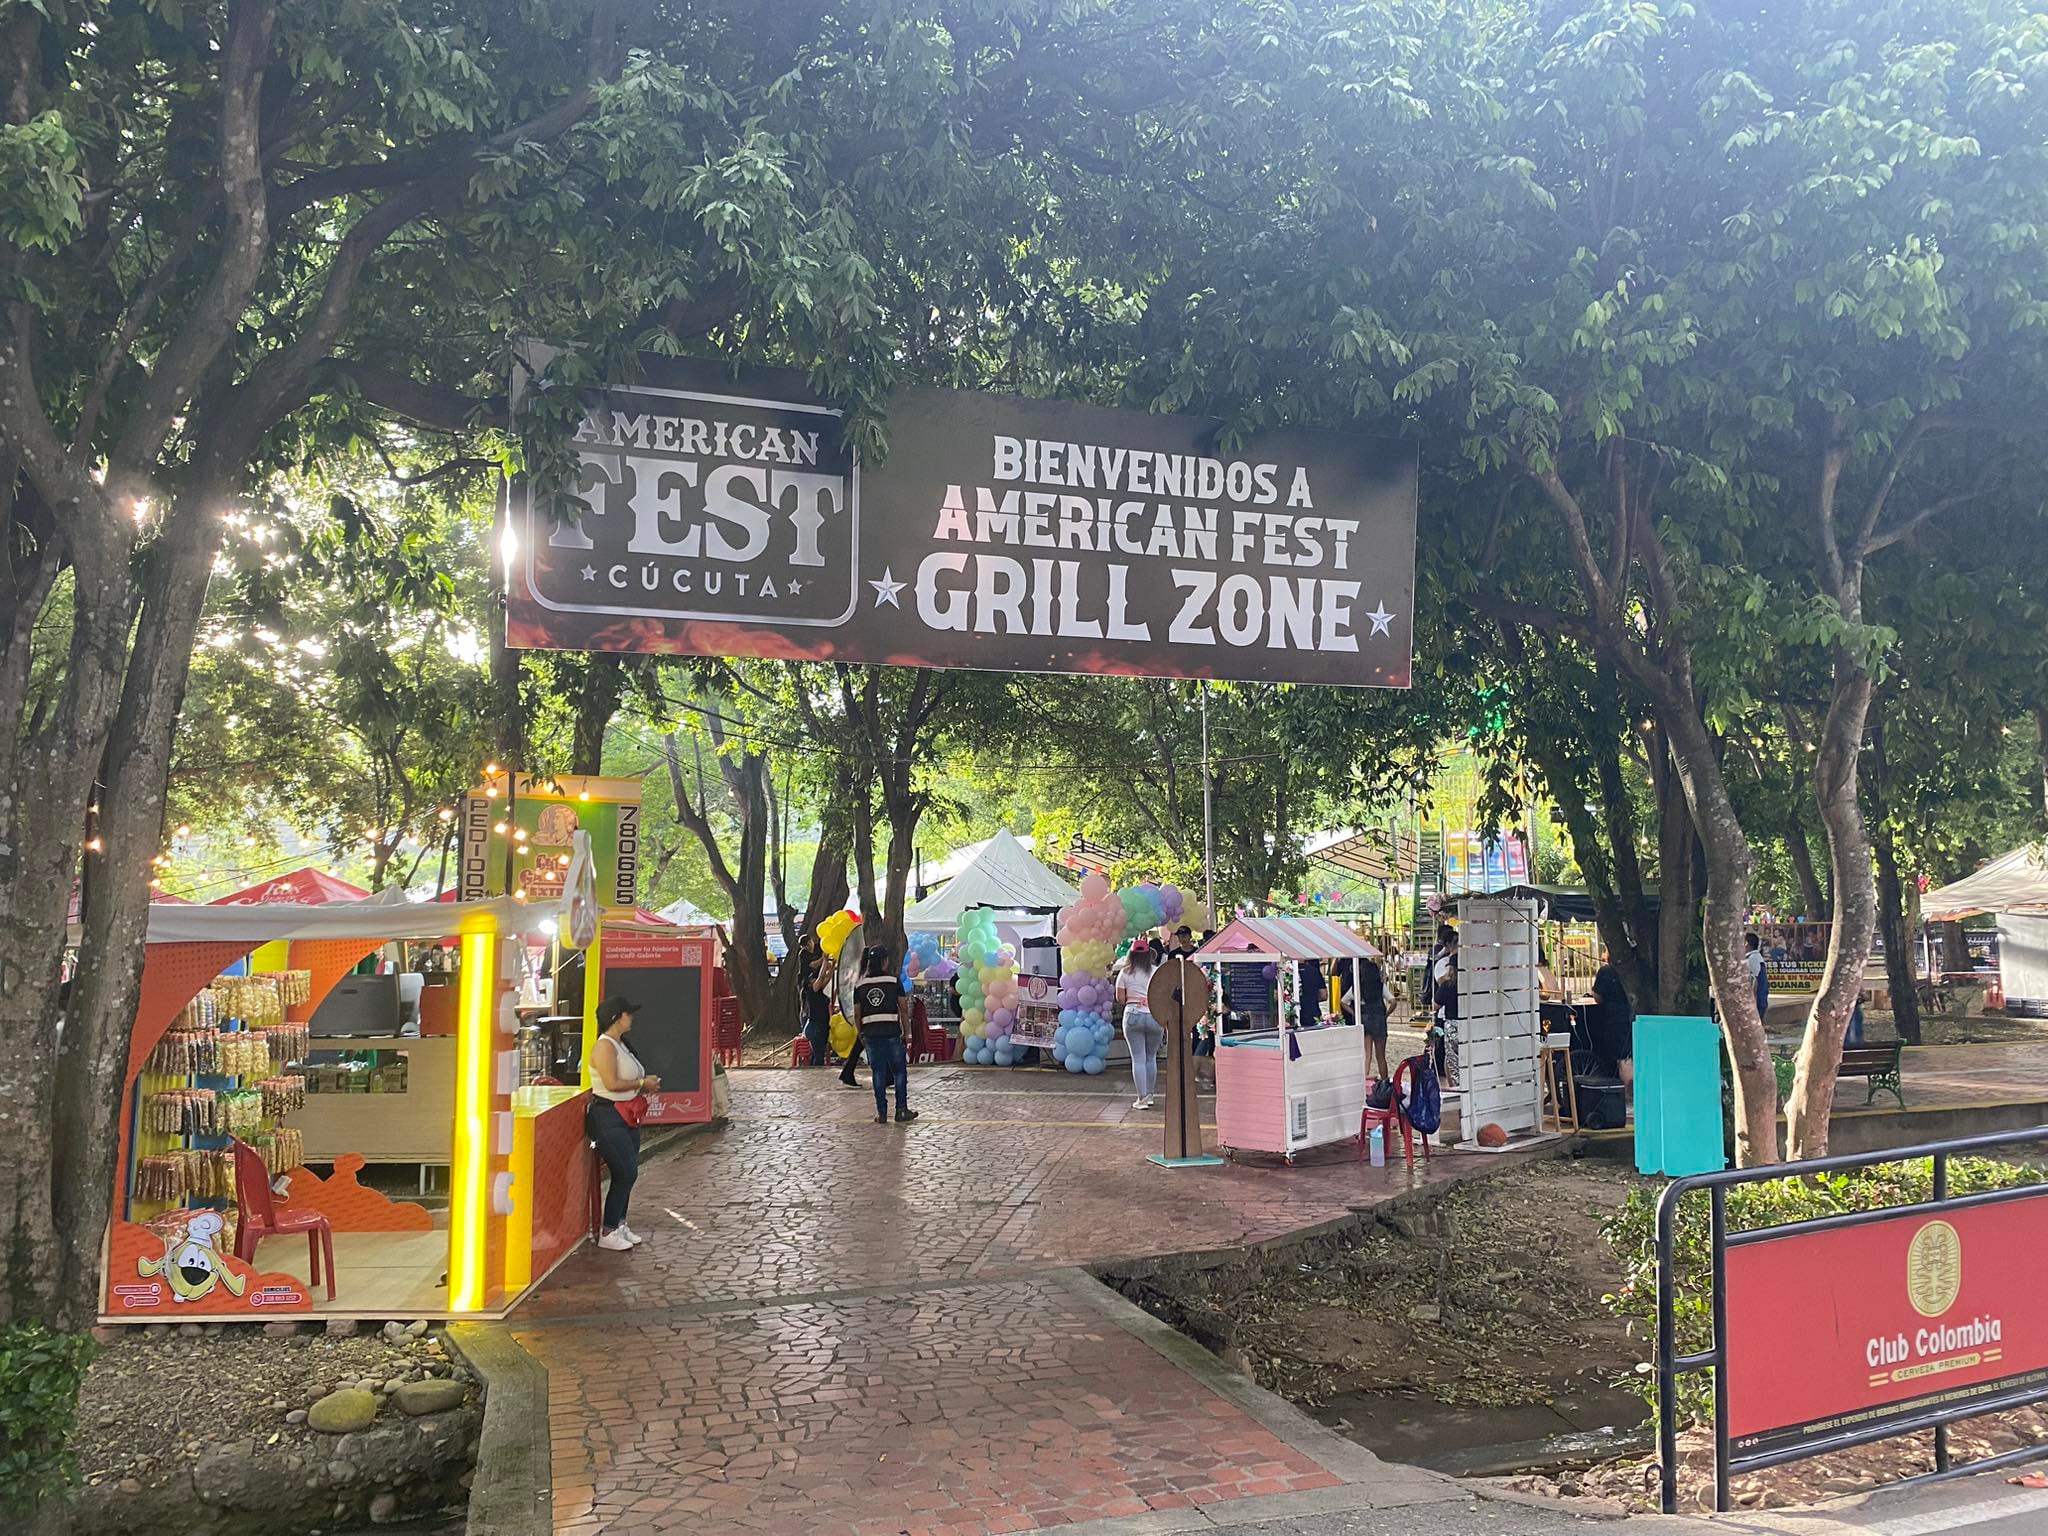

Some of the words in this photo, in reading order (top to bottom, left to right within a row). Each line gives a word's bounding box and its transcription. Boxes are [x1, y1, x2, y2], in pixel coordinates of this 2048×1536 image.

[571, 407, 819, 465] AMERICAN
[993, 435, 1279, 504] BIENVENIDOS
[1286, 467, 1314, 508] A
[549, 451, 844, 567] FEST
[933, 485, 1219, 561] AMERICAN
[1231, 510, 1360, 570] FEST
[608, 561, 778, 598] CÚCUTA
[914, 551, 1152, 642] GRILL
[1168, 568, 1362, 653] ZONE
[616, 806, 638, 905] 780685
[529, 887, 563, 897] EXTR
[1866, 1333, 1909, 1367] Club
[1915, 1314, 2001, 1357] Colombia
[1897, 1366, 1935, 1378] CERVEZA
[1939, 1356, 1977, 1370] PREMIUM
